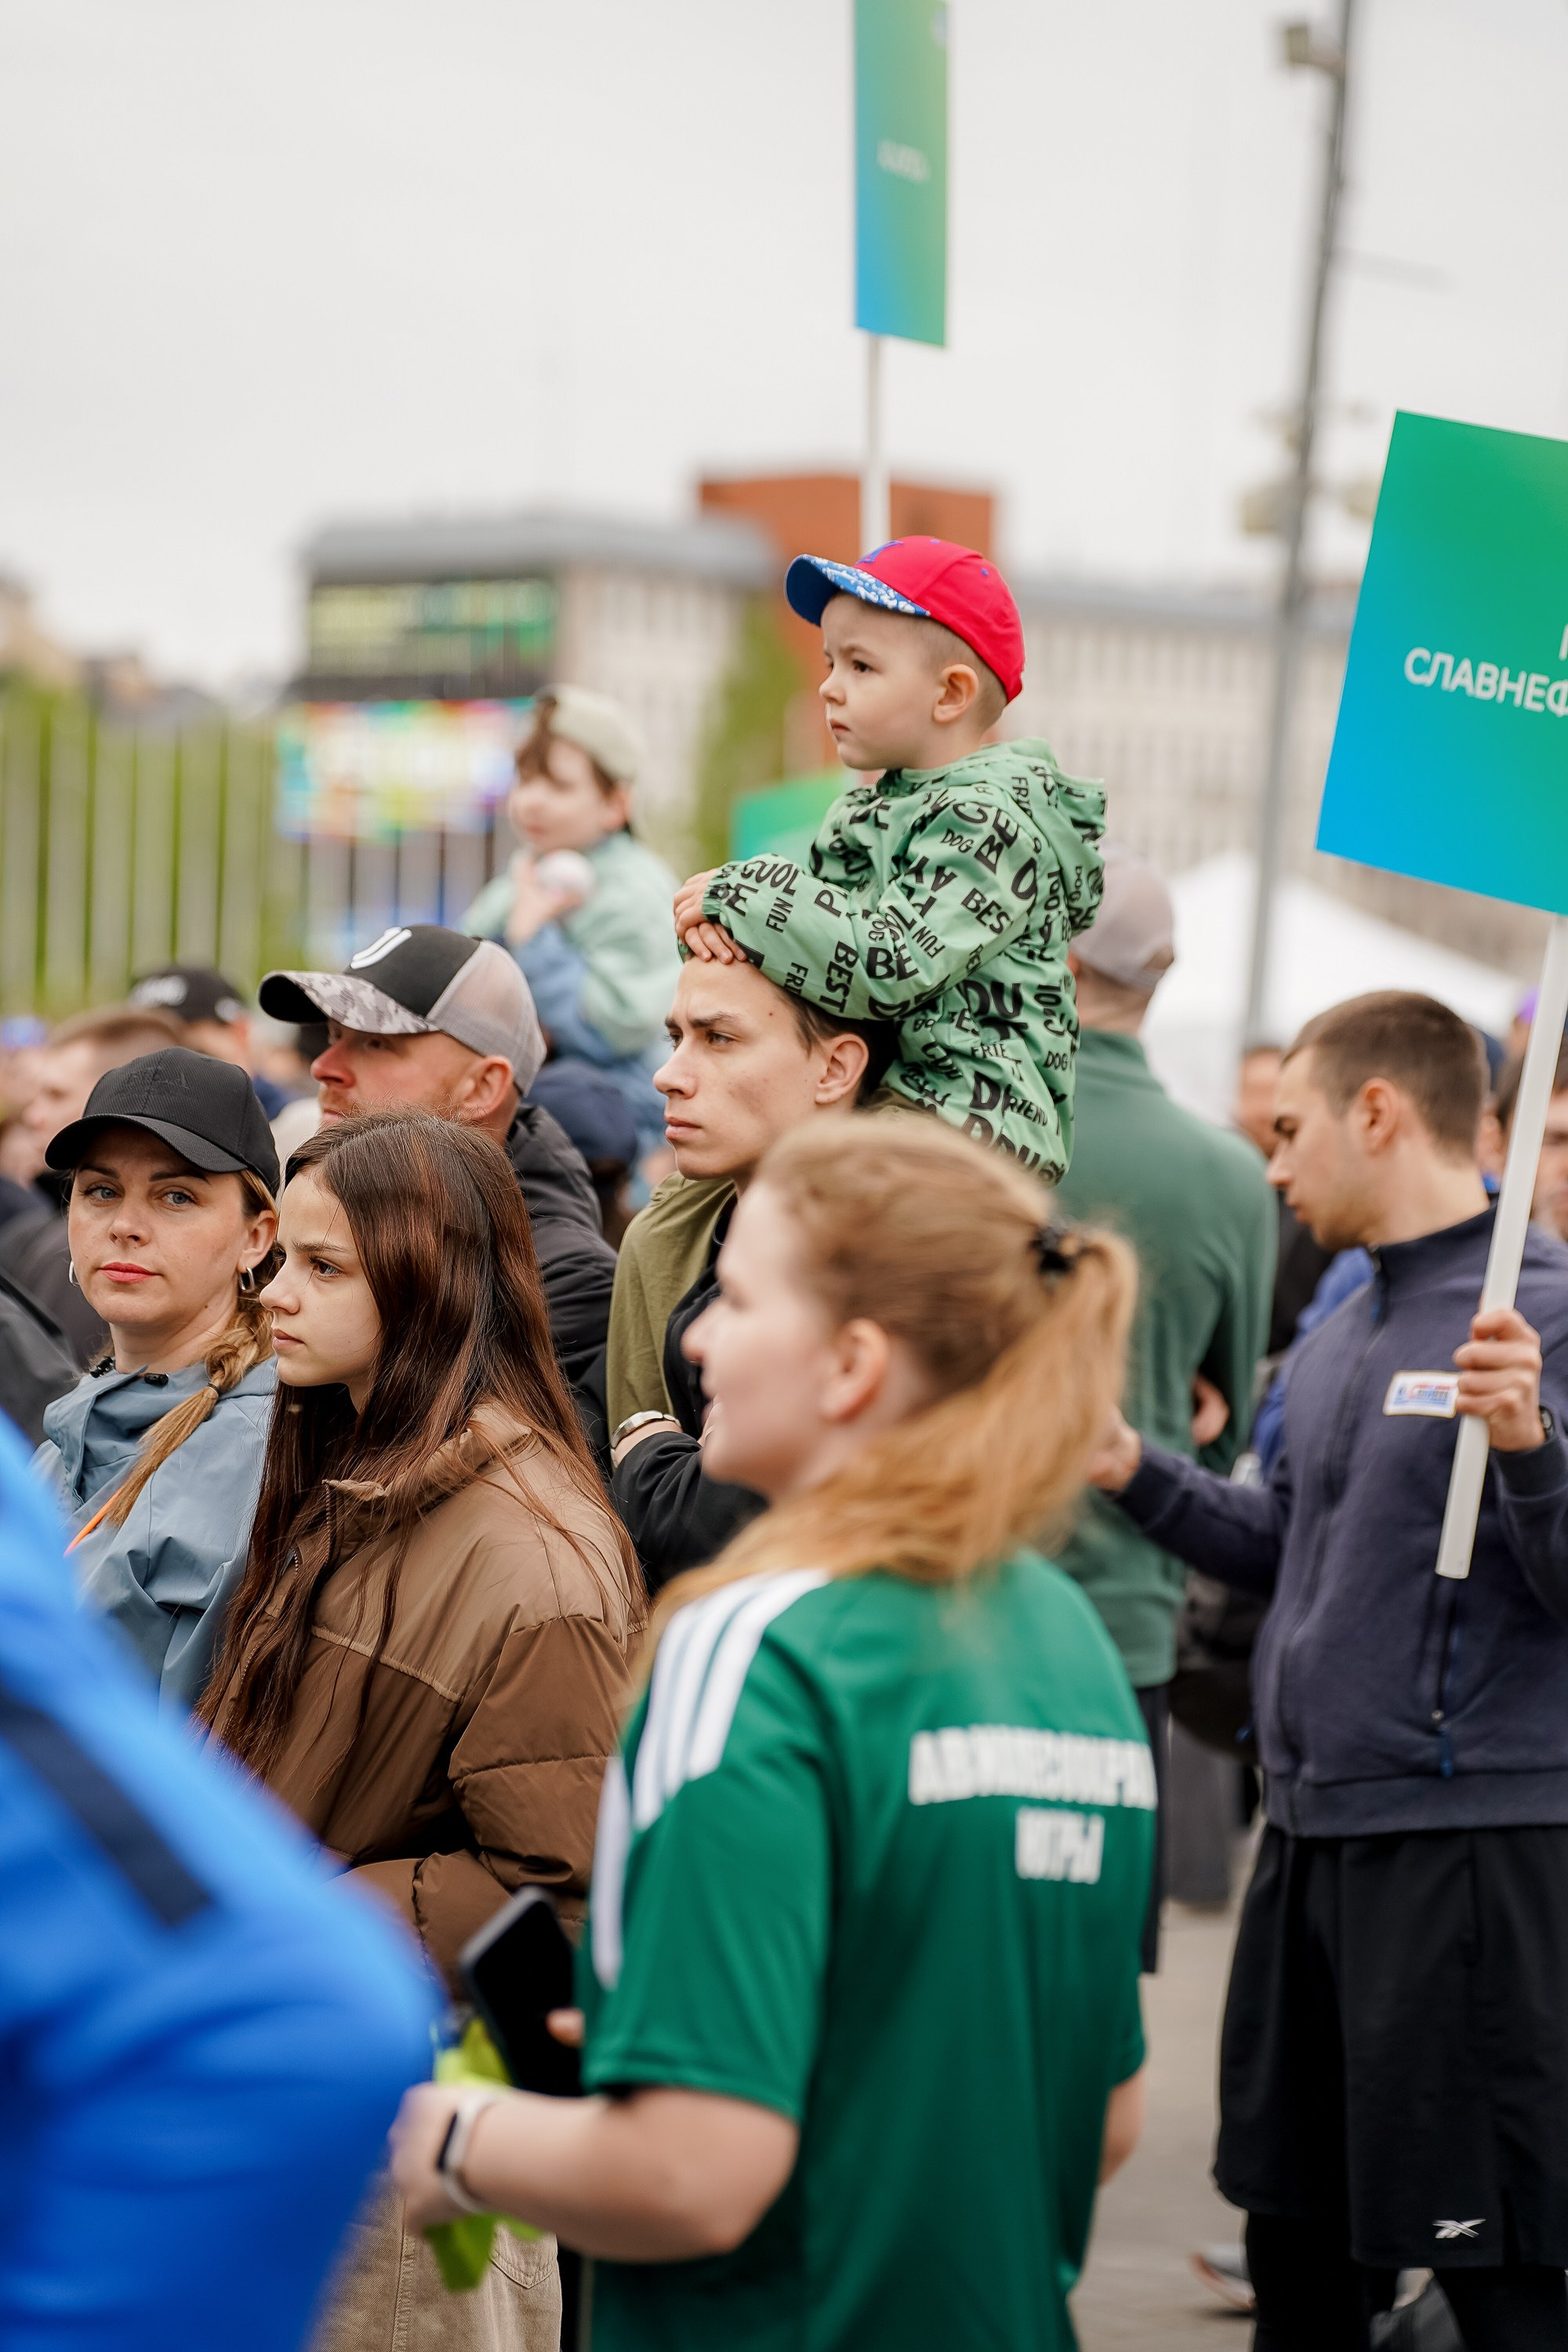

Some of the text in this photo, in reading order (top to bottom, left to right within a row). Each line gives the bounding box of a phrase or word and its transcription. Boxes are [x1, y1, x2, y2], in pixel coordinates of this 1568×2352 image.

[941, 828, 975, 853] DOG
[765, 896, 794, 934] FUN
[960, 887, 1014, 936] BES
[912, 926, 946, 959] FUN
[819, 940, 859, 1014] BEST
[1043, 1051, 1069, 1072] DOG
